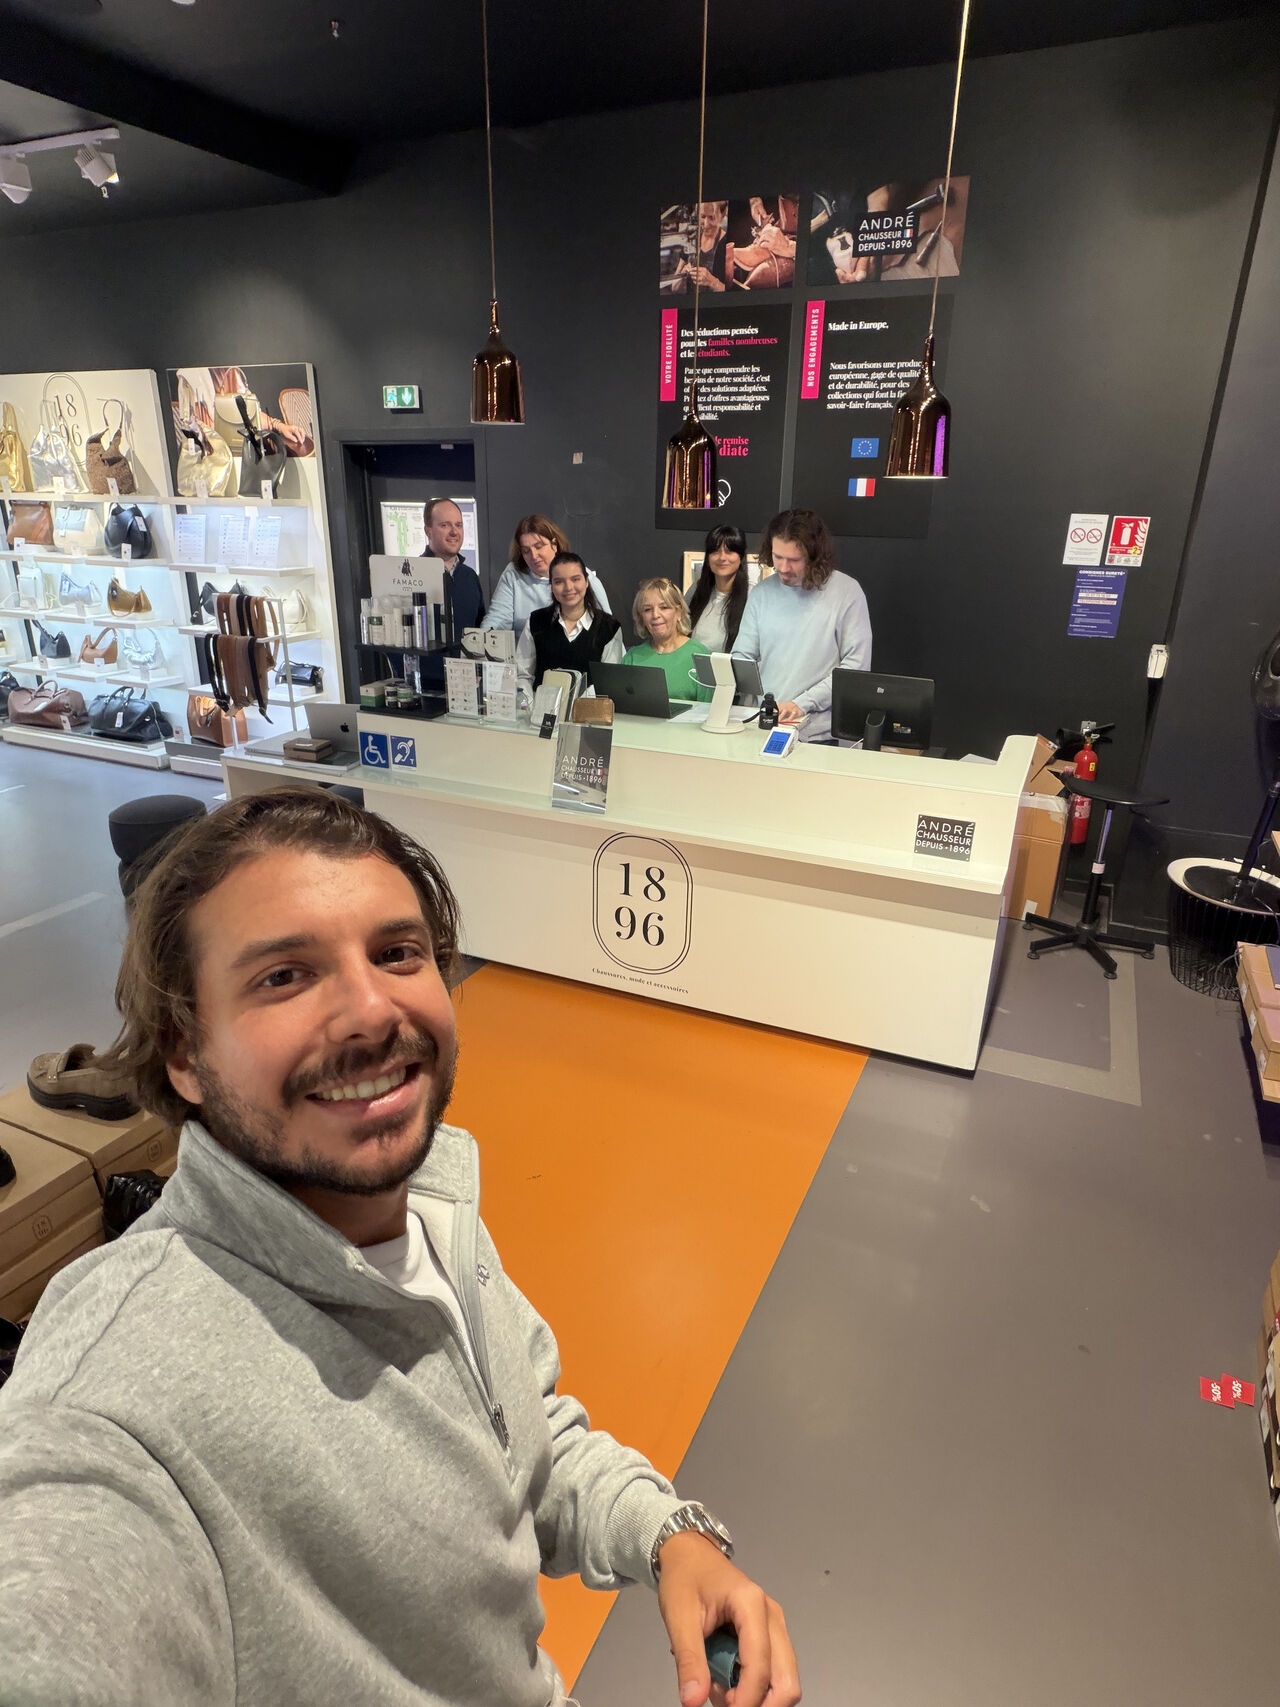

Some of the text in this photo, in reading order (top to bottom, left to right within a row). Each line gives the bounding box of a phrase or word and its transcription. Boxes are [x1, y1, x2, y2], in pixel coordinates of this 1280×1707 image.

[859, 212, 914, 230] ANDRÉ
[858, 231, 902, 241] CHAUSSEUR
[858, 242, 886, 252] DEPUIS
[731, 326, 759, 336] pensées
[828, 321, 889, 331] Made in Europe.
[680, 336, 778, 349] pou les familles nombreuses
[806, 308, 820, 387] NOS ENGAGEMENTS
[714, 365, 750, 374] comprendre
[848, 361, 882, 370] favorisons
[897, 359, 936, 370] produc
[870, 372, 887, 380] gage
[887, 370, 897, 378] de
[897, 369, 921, 380] qualité
[836, 382, 844, 390] de
[897, 380, 910, 388] des
[827, 390, 907, 400] collections qui font la fie
[712, 403, 754, 412] responsabilité
[826, 401, 865, 409] savoir-faire
[723, 436, 750, 445] remise
[719, 445, 749, 456] diate
[392, 578, 424, 587] FAMACO
[562, 755, 604, 768] ANDRÉ
[560, 765, 595, 774] CHAUSSEUR
[918, 820, 975, 837] ANDRÉ
[916, 830, 972, 846] CHAUSSEUR
[916, 840, 944, 850] DEPUIS
[620, 862, 666, 902] 18
[614, 906, 664, 946] 96
[592, 967, 628, 981] Chaussures,
[653, 983, 689, 994] accessoires
[1211, 1382, 1222, 1402] -50%
[1232, 1380, 1242, 1399] -50%
